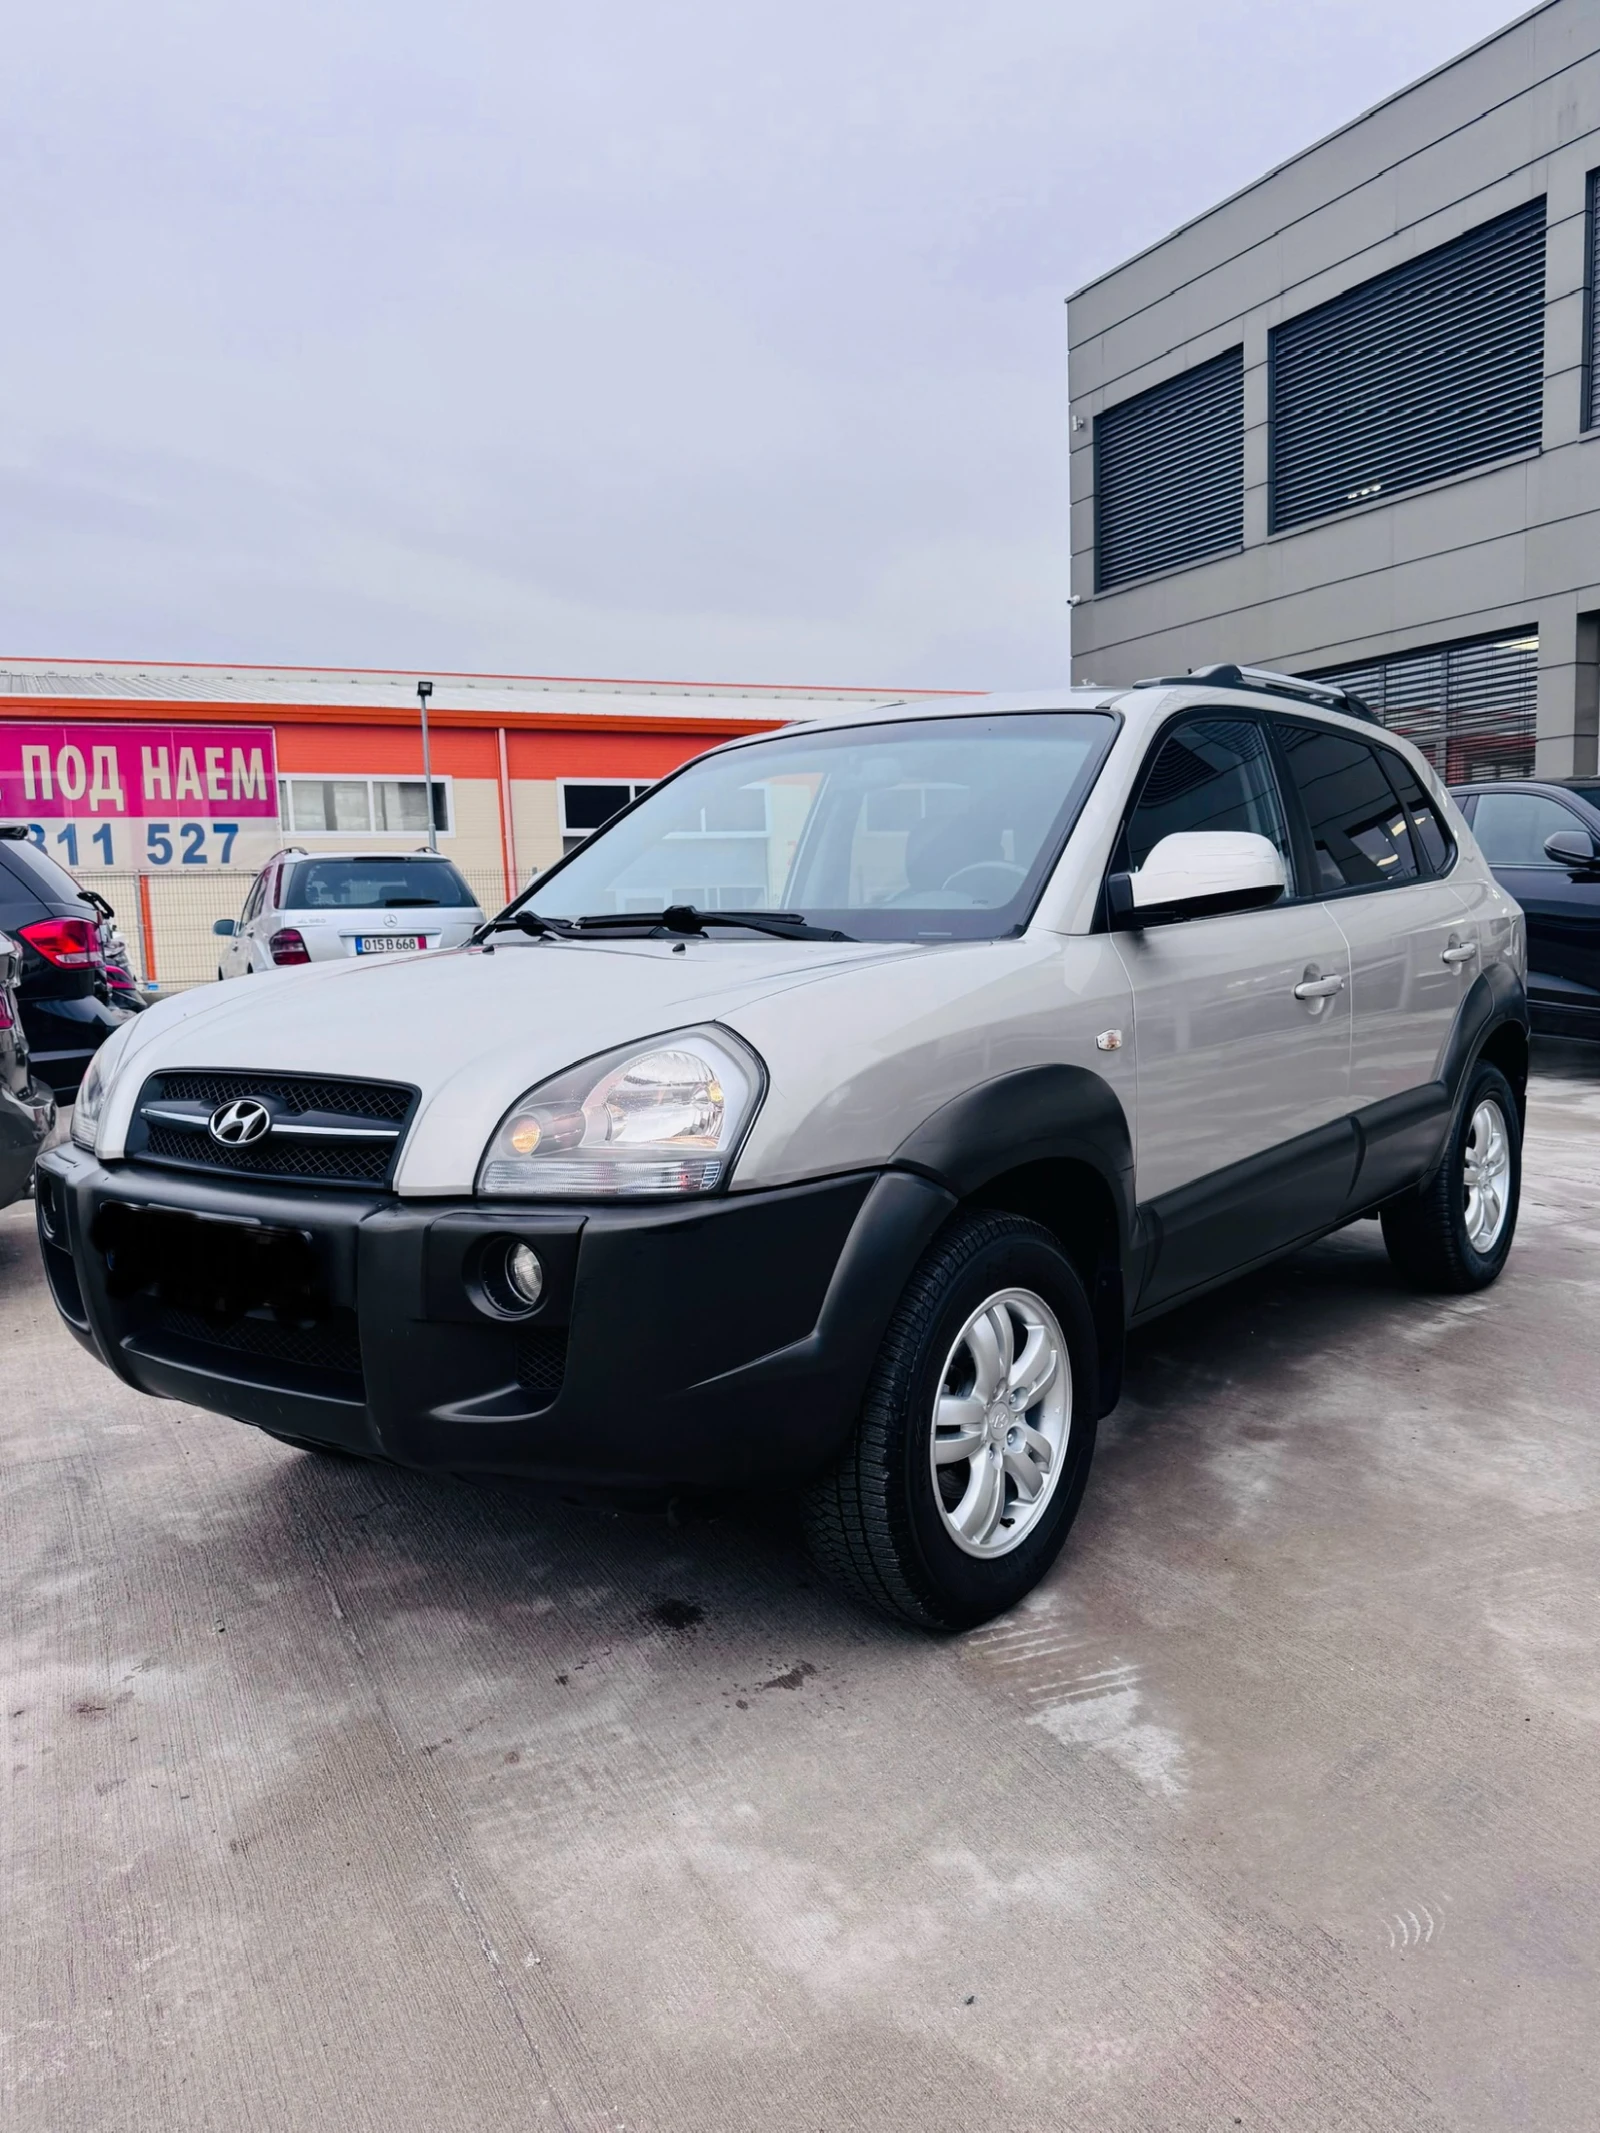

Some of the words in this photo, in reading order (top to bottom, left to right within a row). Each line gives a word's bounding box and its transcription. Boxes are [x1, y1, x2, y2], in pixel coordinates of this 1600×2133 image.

[21, 745, 125, 812] ПОД
[141, 746, 268, 801] НАЕМ
[147, 823, 240, 865] 527
